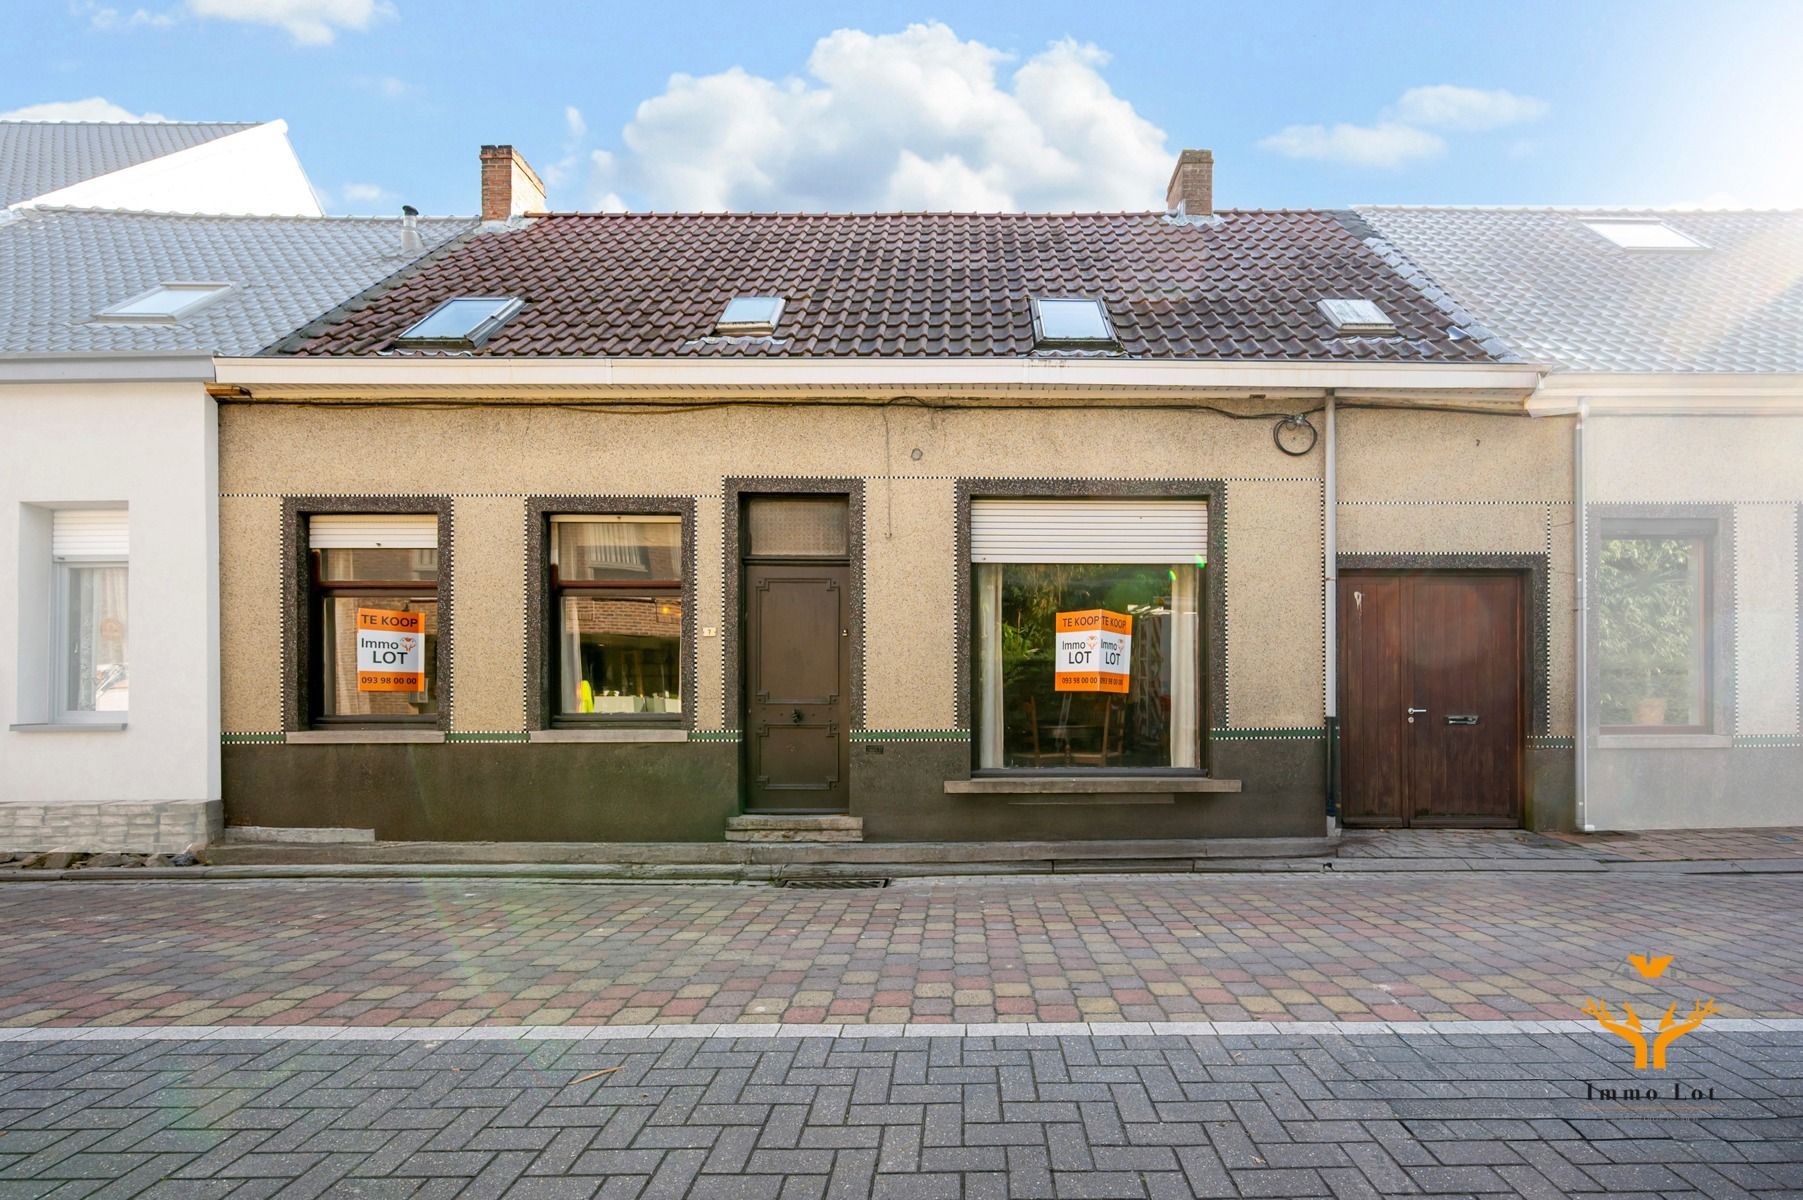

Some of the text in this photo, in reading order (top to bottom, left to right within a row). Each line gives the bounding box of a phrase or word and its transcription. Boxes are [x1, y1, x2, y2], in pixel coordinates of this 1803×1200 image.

[361, 614, 418, 627] TE KOOP
[1062, 615, 1099, 627] TE KOOP
[1102, 615, 1127, 629] TE KOOP
[361, 637, 399, 650] Immo
[1062, 640, 1086, 650] Immo
[1100, 638, 1118, 651] Immo
[372, 650, 408, 664] LOT
[1068, 651, 1092, 664] LOT
[1105, 652, 1120, 666] LOT
[361, 676, 378, 684] 093
[1062, 676, 1072, 684] 093
[1081, 676, 1089, 684] 00
[1090, 676, 1098, 684] 00
